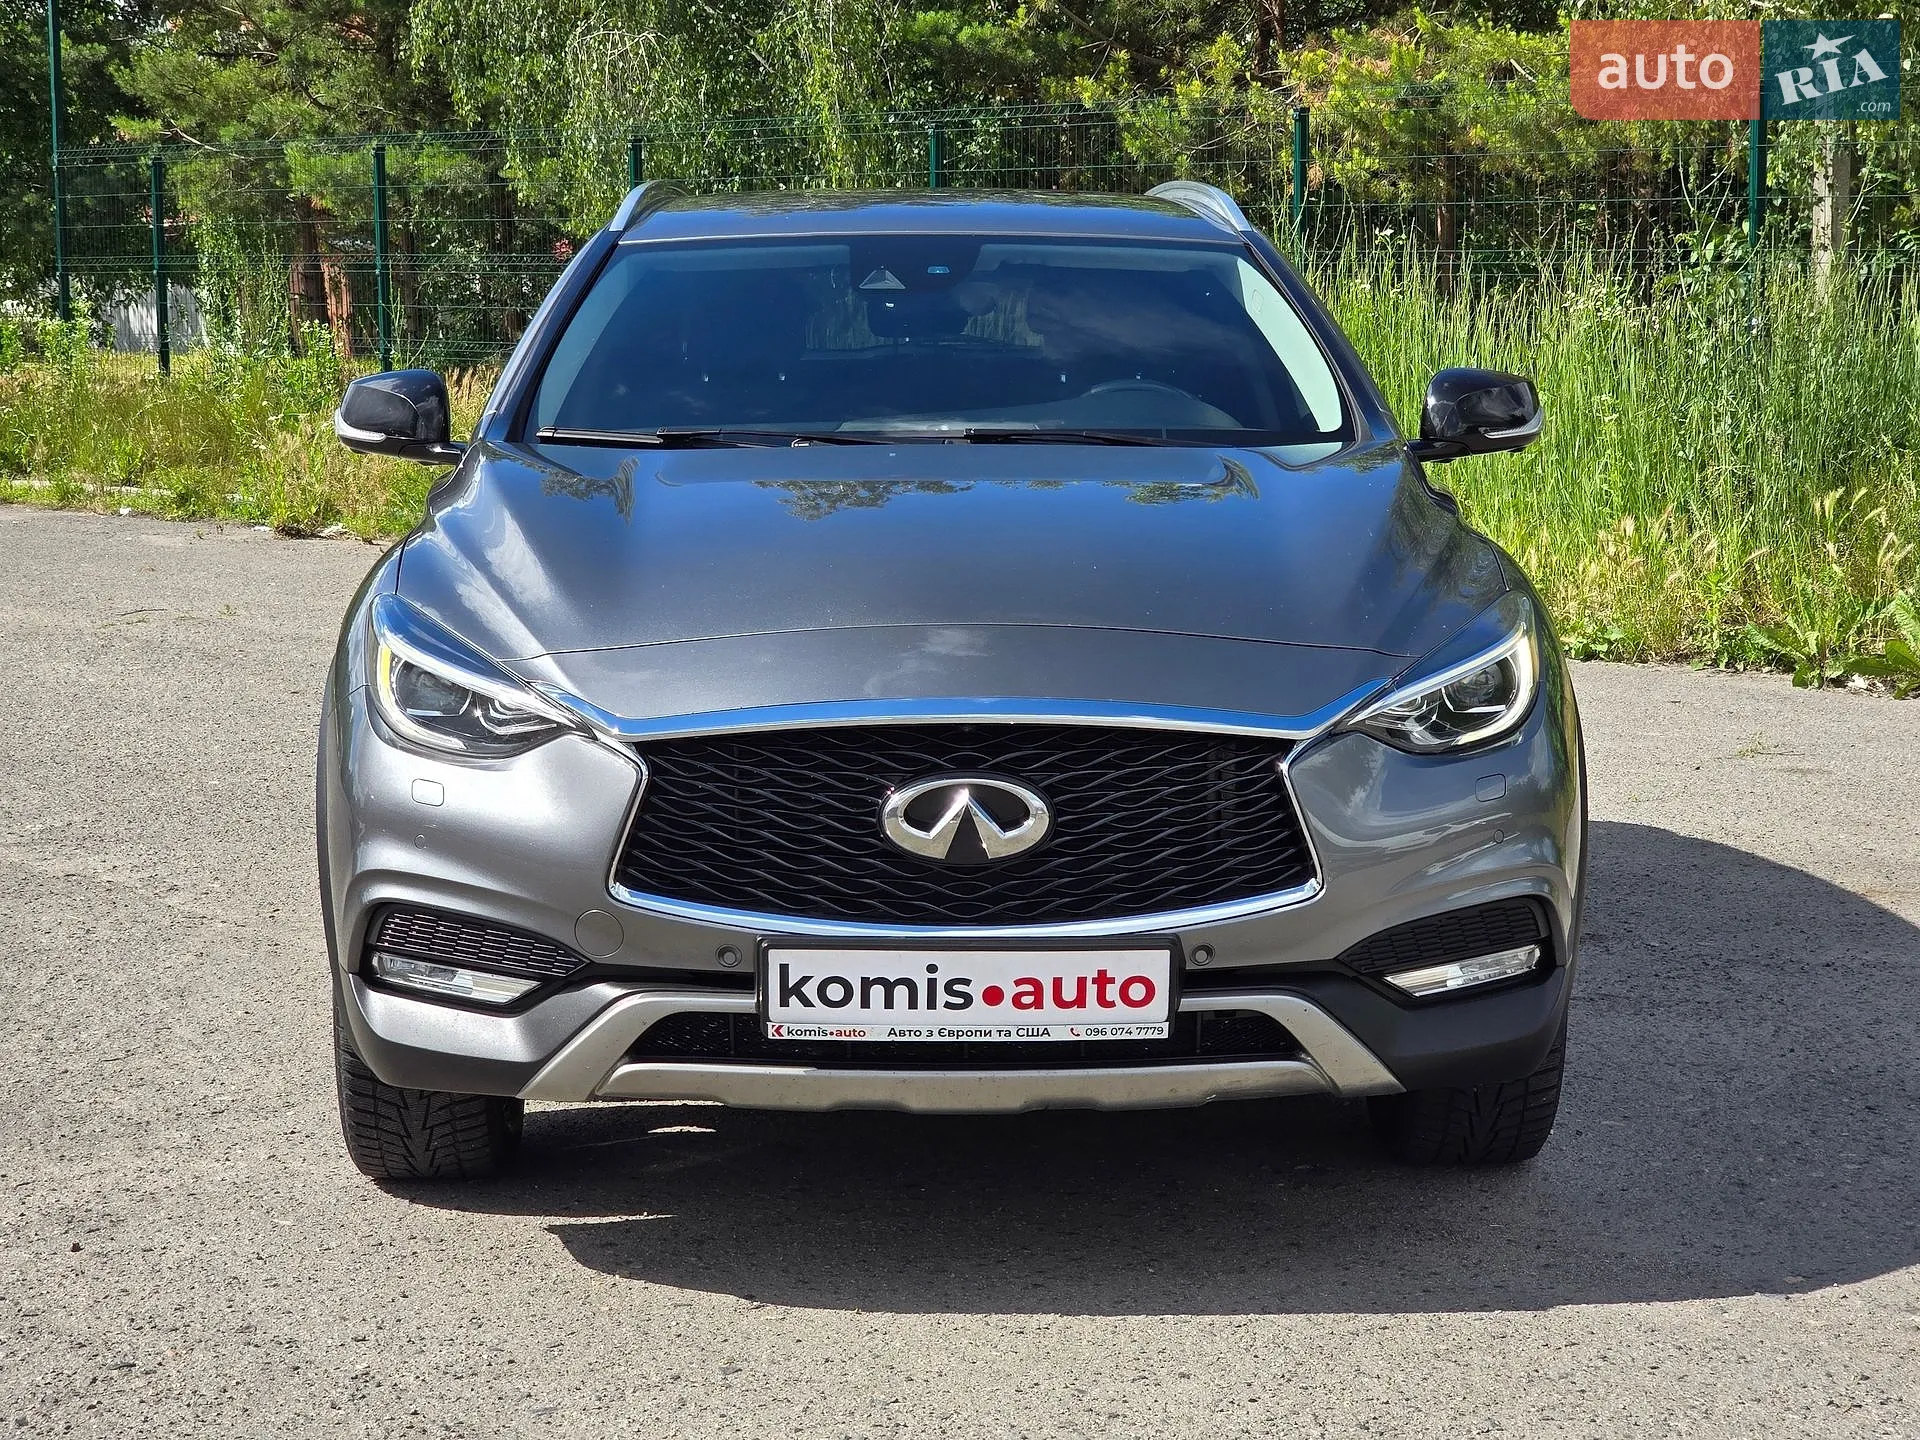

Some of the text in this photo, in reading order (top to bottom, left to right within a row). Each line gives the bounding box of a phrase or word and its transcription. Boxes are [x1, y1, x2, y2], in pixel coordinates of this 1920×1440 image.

[886, 1027, 1051, 1041] Авто з Європи та США
[1084, 1026, 1165, 1037] 096 074 7779
